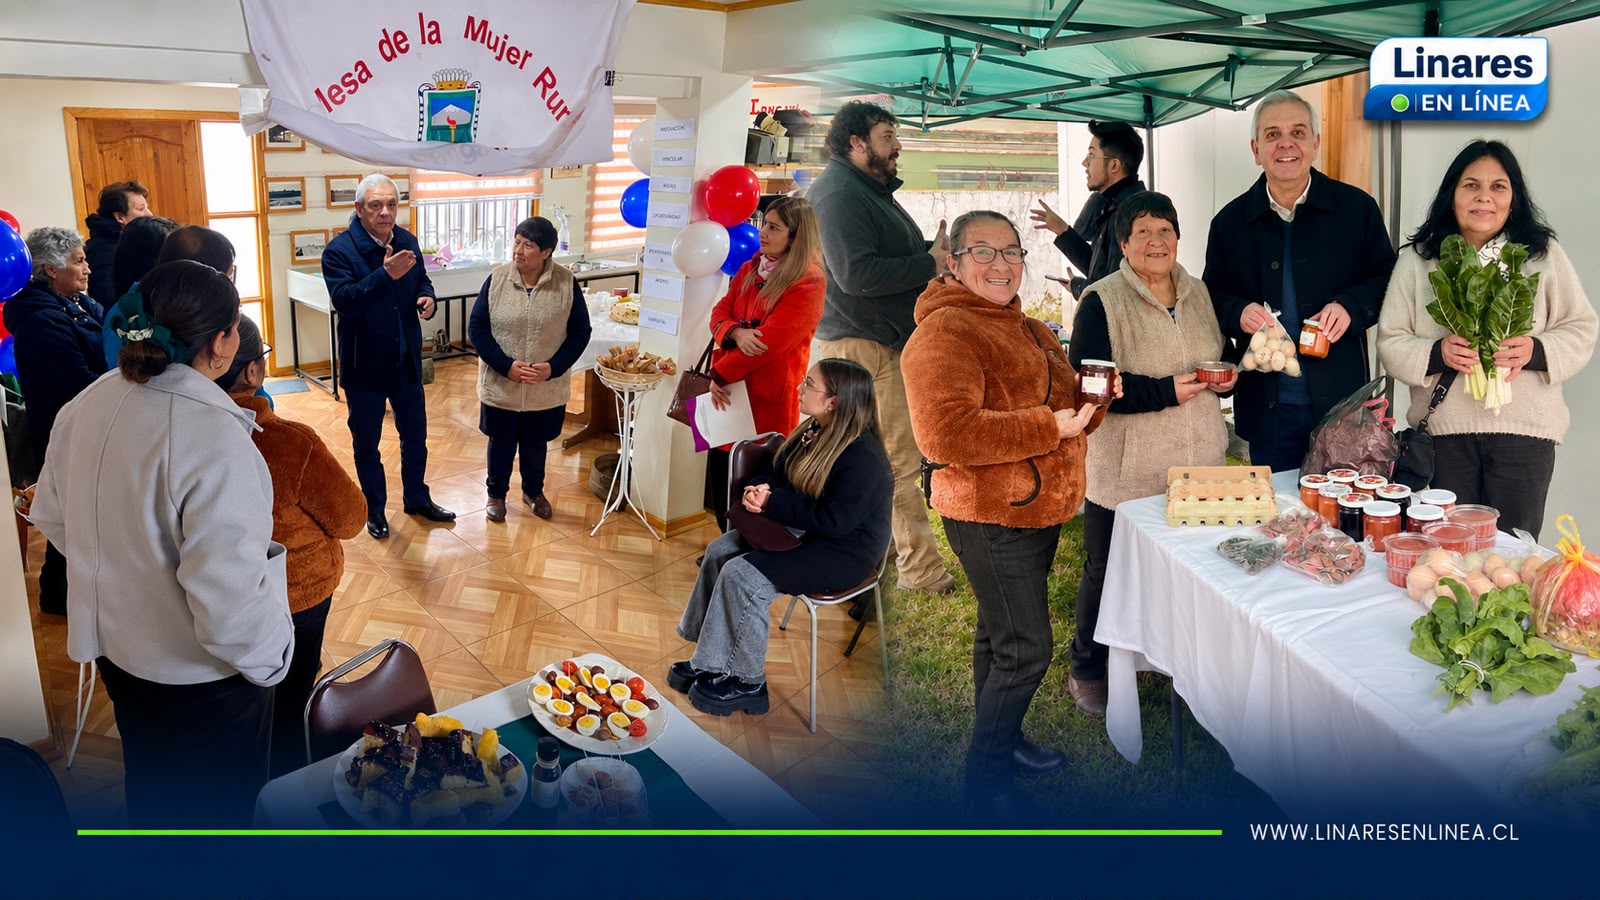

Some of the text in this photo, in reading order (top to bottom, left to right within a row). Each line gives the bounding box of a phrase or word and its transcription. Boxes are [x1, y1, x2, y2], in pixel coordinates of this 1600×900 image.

[378, 28, 411, 63] de
[418, 12, 442, 45] la
[464, 15, 533, 70] Mujer
